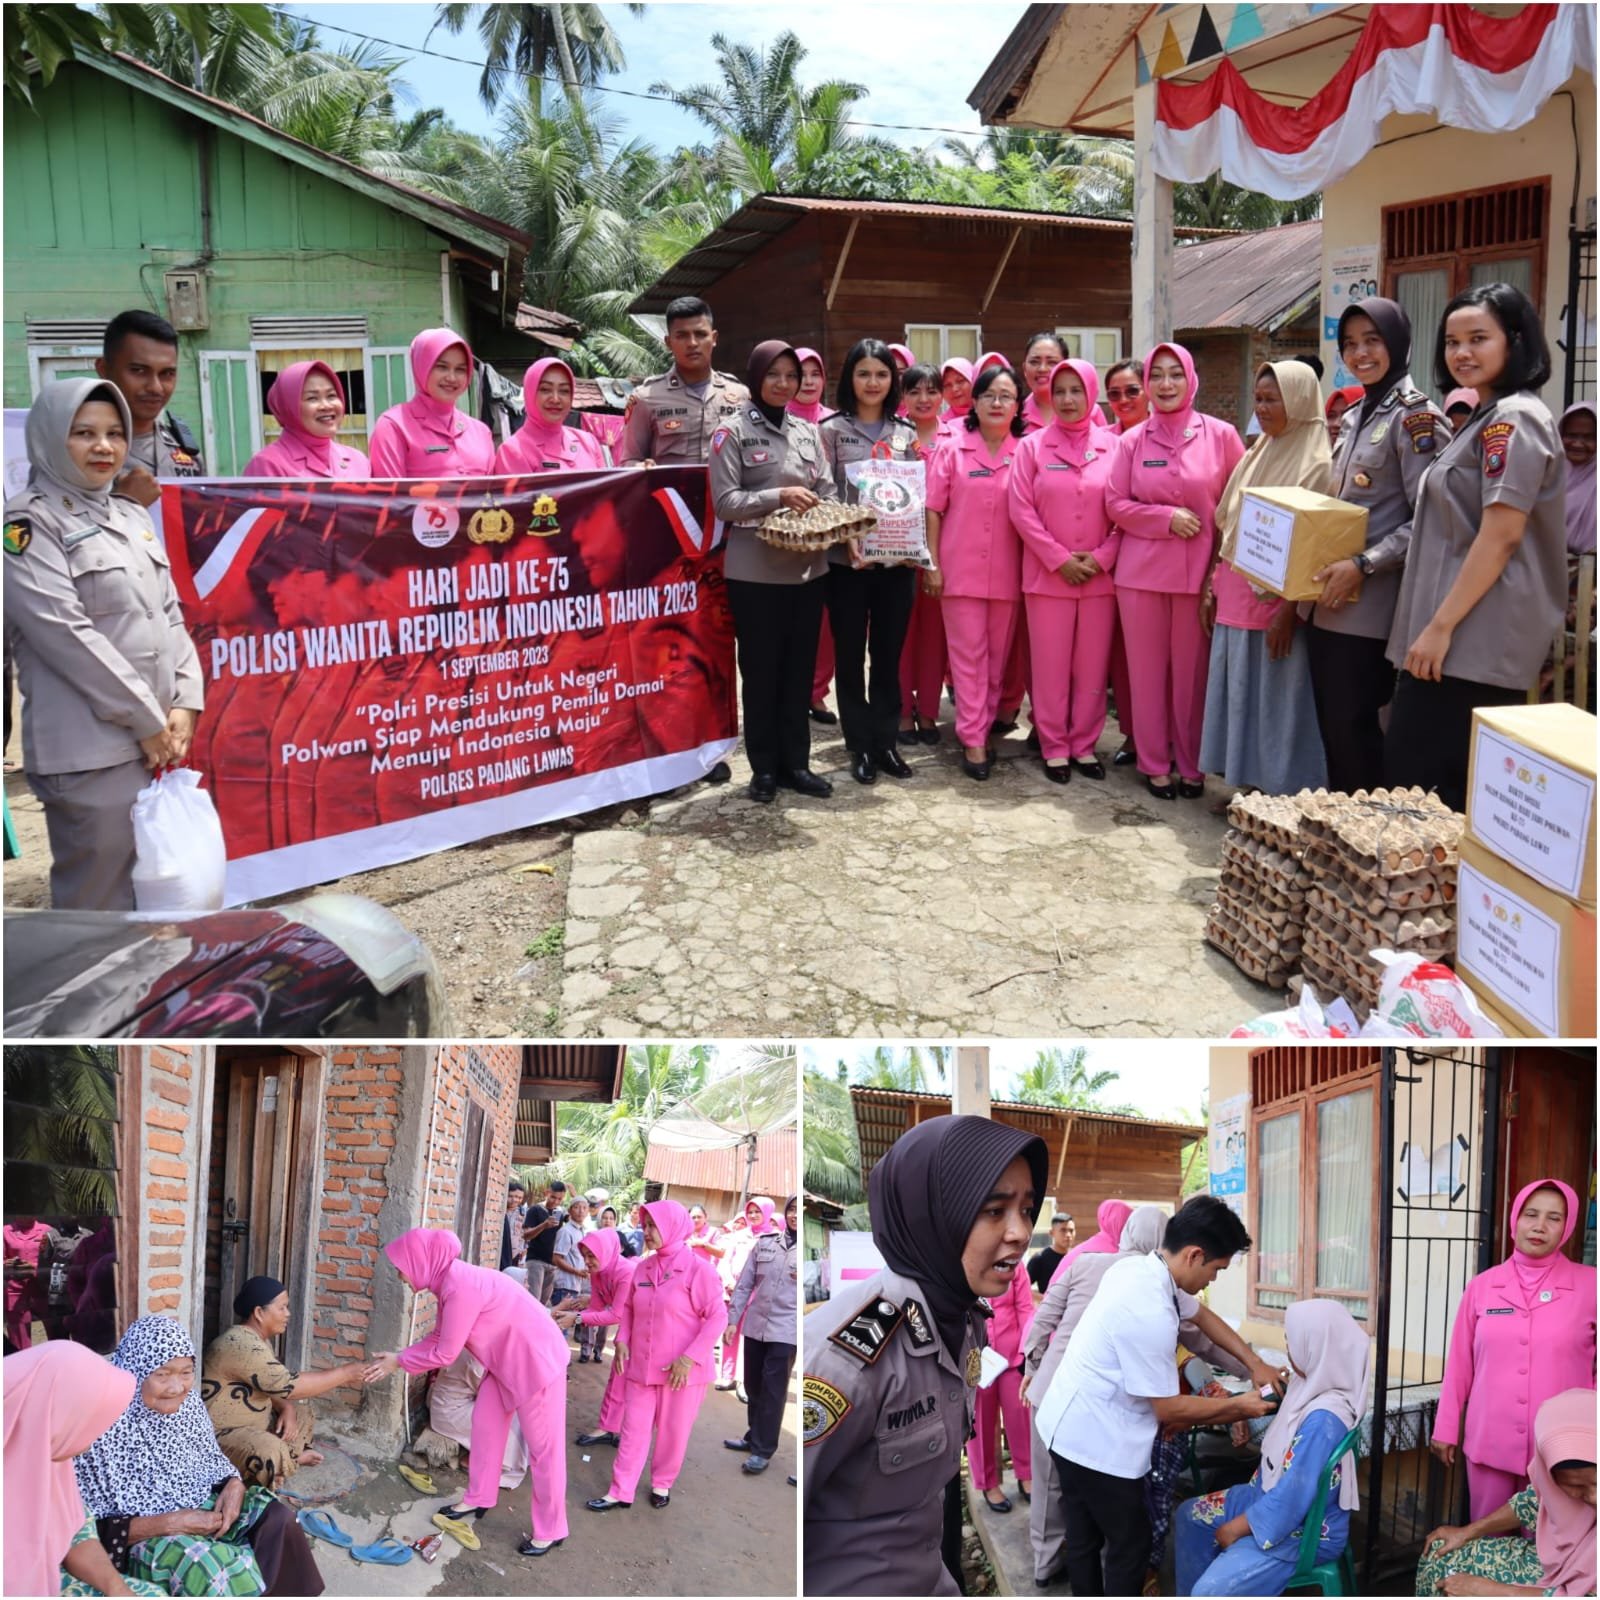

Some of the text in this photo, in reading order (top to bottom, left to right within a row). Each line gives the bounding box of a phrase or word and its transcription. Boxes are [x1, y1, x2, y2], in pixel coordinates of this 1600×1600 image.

[408, 556, 570, 608] HARI JADI KE-75
[211, 580, 698, 680] POLISI WANITA REPUBLIK INDONESIA TAHUN 2023
[440, 645, 549, 681] 1 SEPTEMBER 2023
[425, 687, 489, 715] Presisi
[497, 675, 554, 701] Untuk
[561, 664, 618, 690] Negeri
[281, 675, 665, 765] Polwan Siap Mendukung Pemilu Damai
[370, 743, 451, 775] Menuju
[458, 723, 551, 755] Indonesia
[420, 745, 575, 800] POLRES PADANG LAWAS
[840, 1330, 874, 1356] POLISI
[805, 1381, 844, 1410] SDM POLRI
